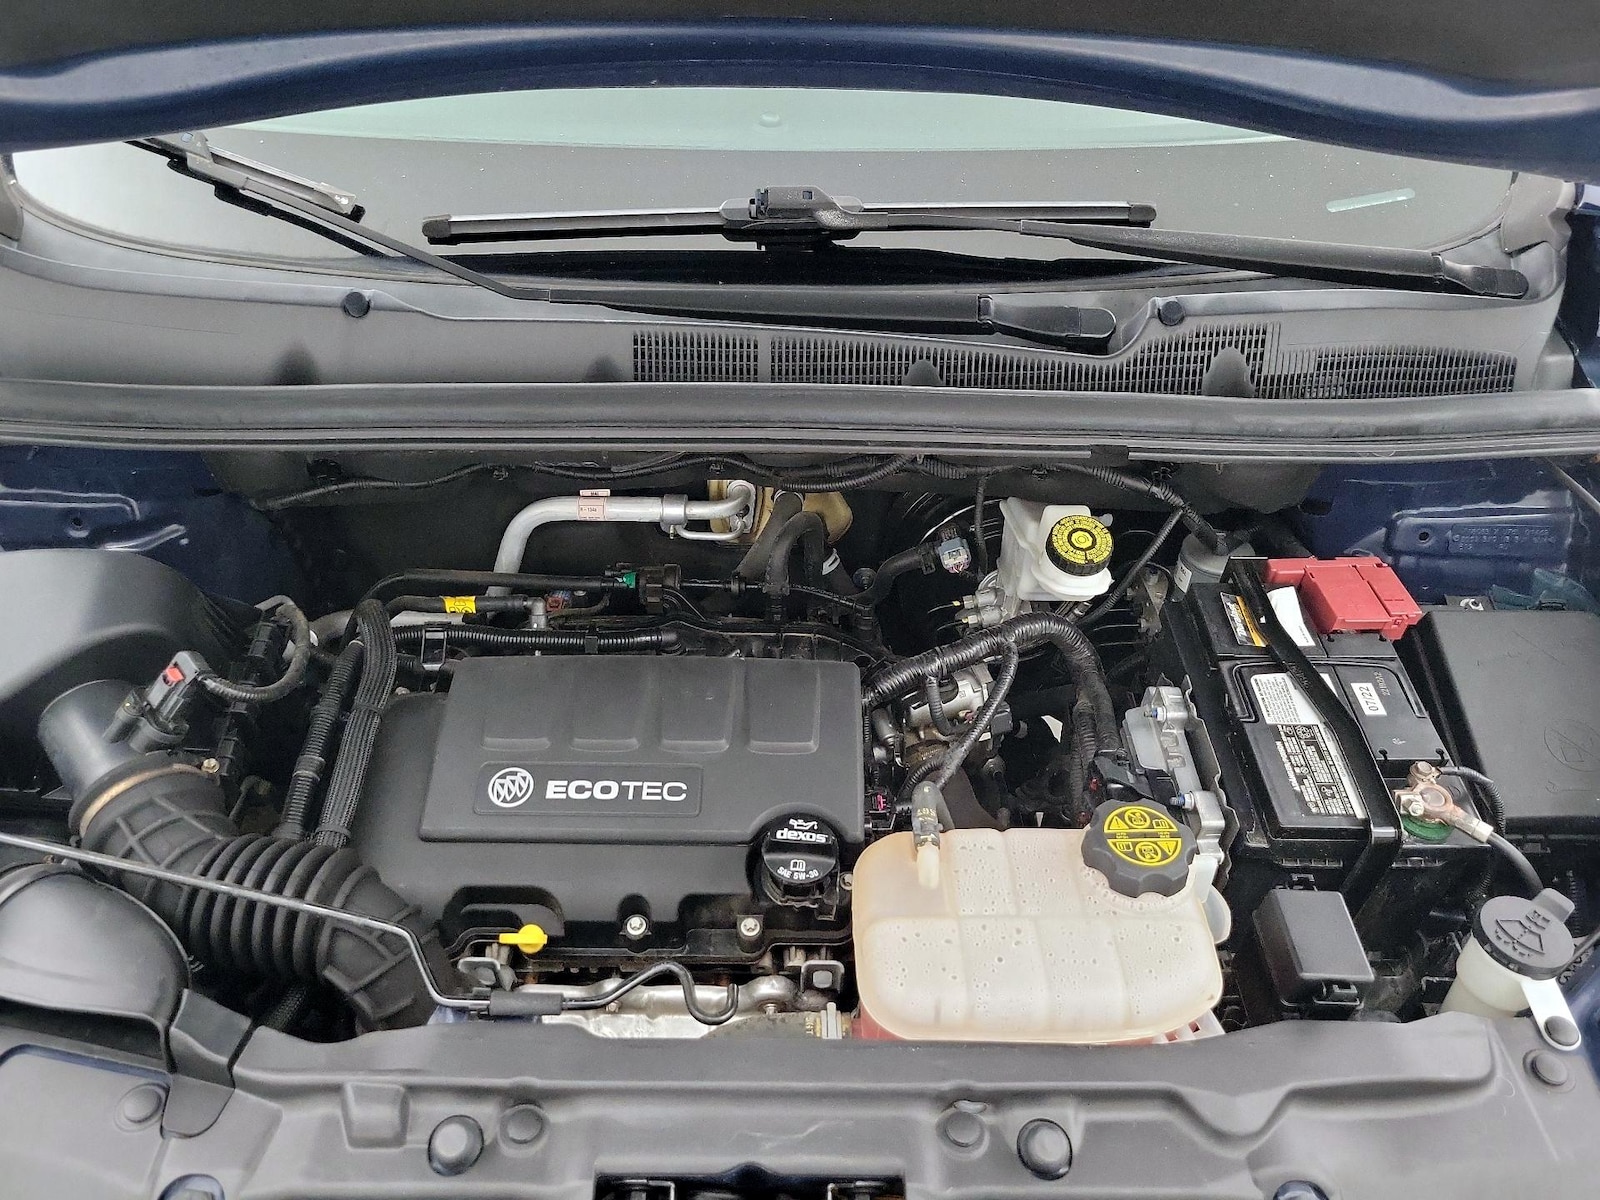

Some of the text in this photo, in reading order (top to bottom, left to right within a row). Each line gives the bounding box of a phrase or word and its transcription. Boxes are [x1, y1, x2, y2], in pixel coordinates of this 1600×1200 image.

[1359, 686, 1379, 711] 07/22
[545, 780, 688, 801] ECOTEC
[776, 828, 826, 843] dexos
[777, 866, 819, 880] SAE 5W-30
